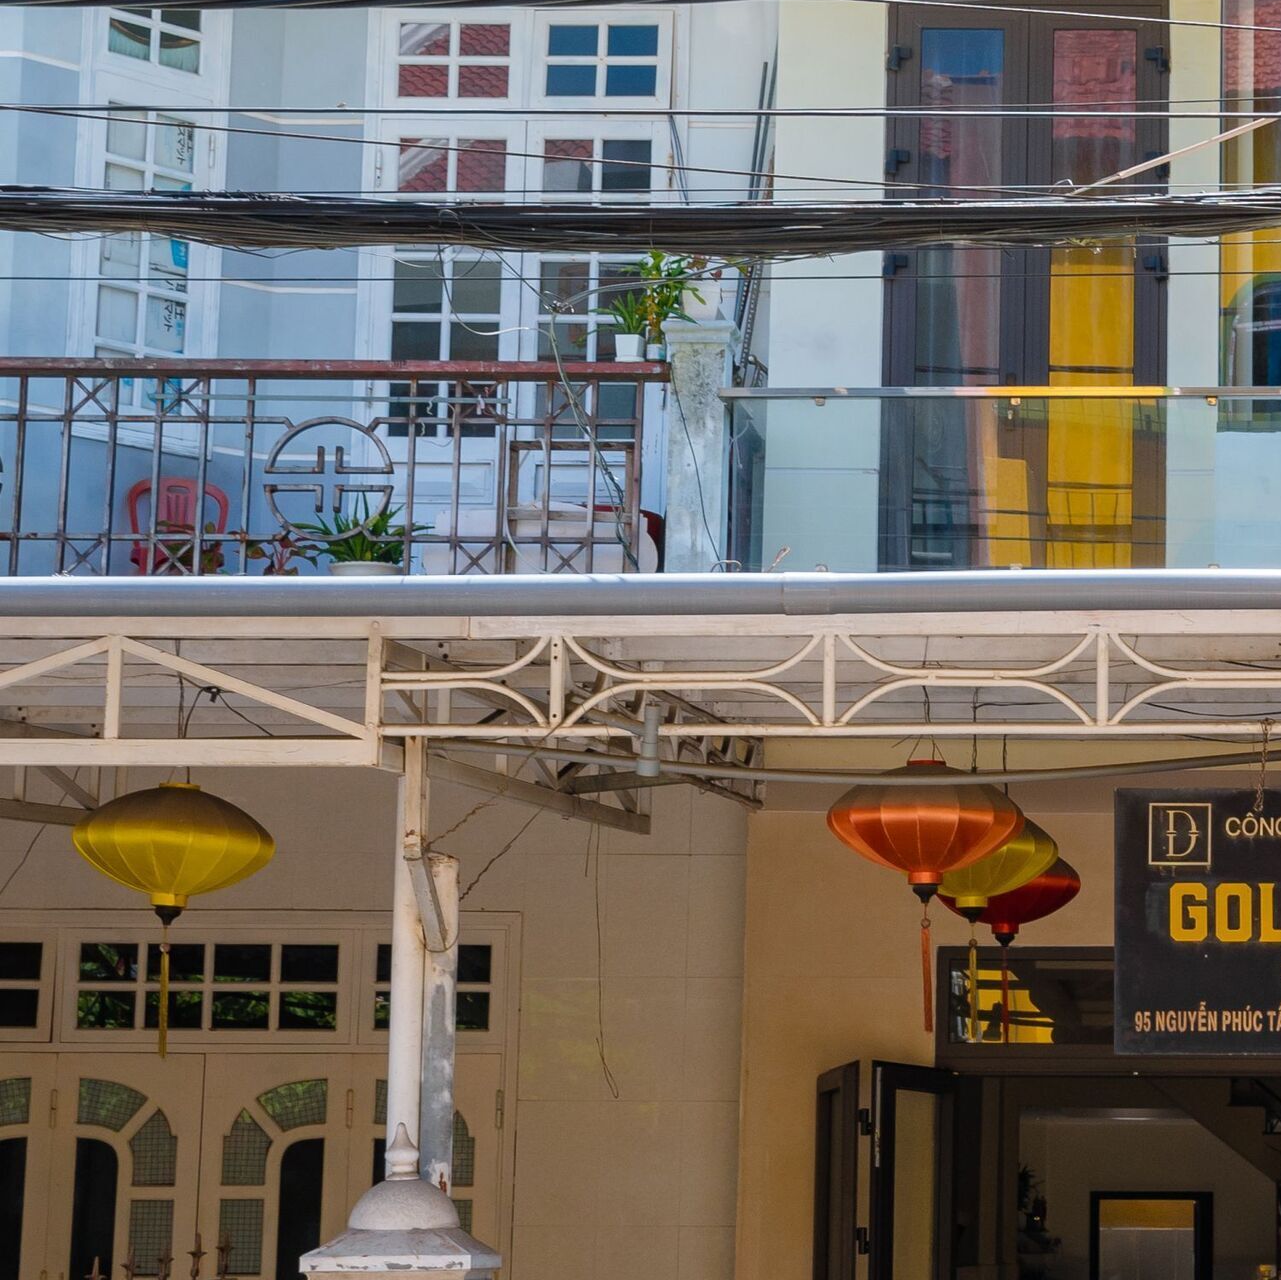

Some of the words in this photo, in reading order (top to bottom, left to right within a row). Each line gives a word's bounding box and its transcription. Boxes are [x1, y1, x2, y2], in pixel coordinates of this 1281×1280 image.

[1134, 1010, 1151, 1032] 95
[1155, 1001, 1218, 1032] NGUYỄN
[1222, 1005, 1263, 1033] PHÚC
